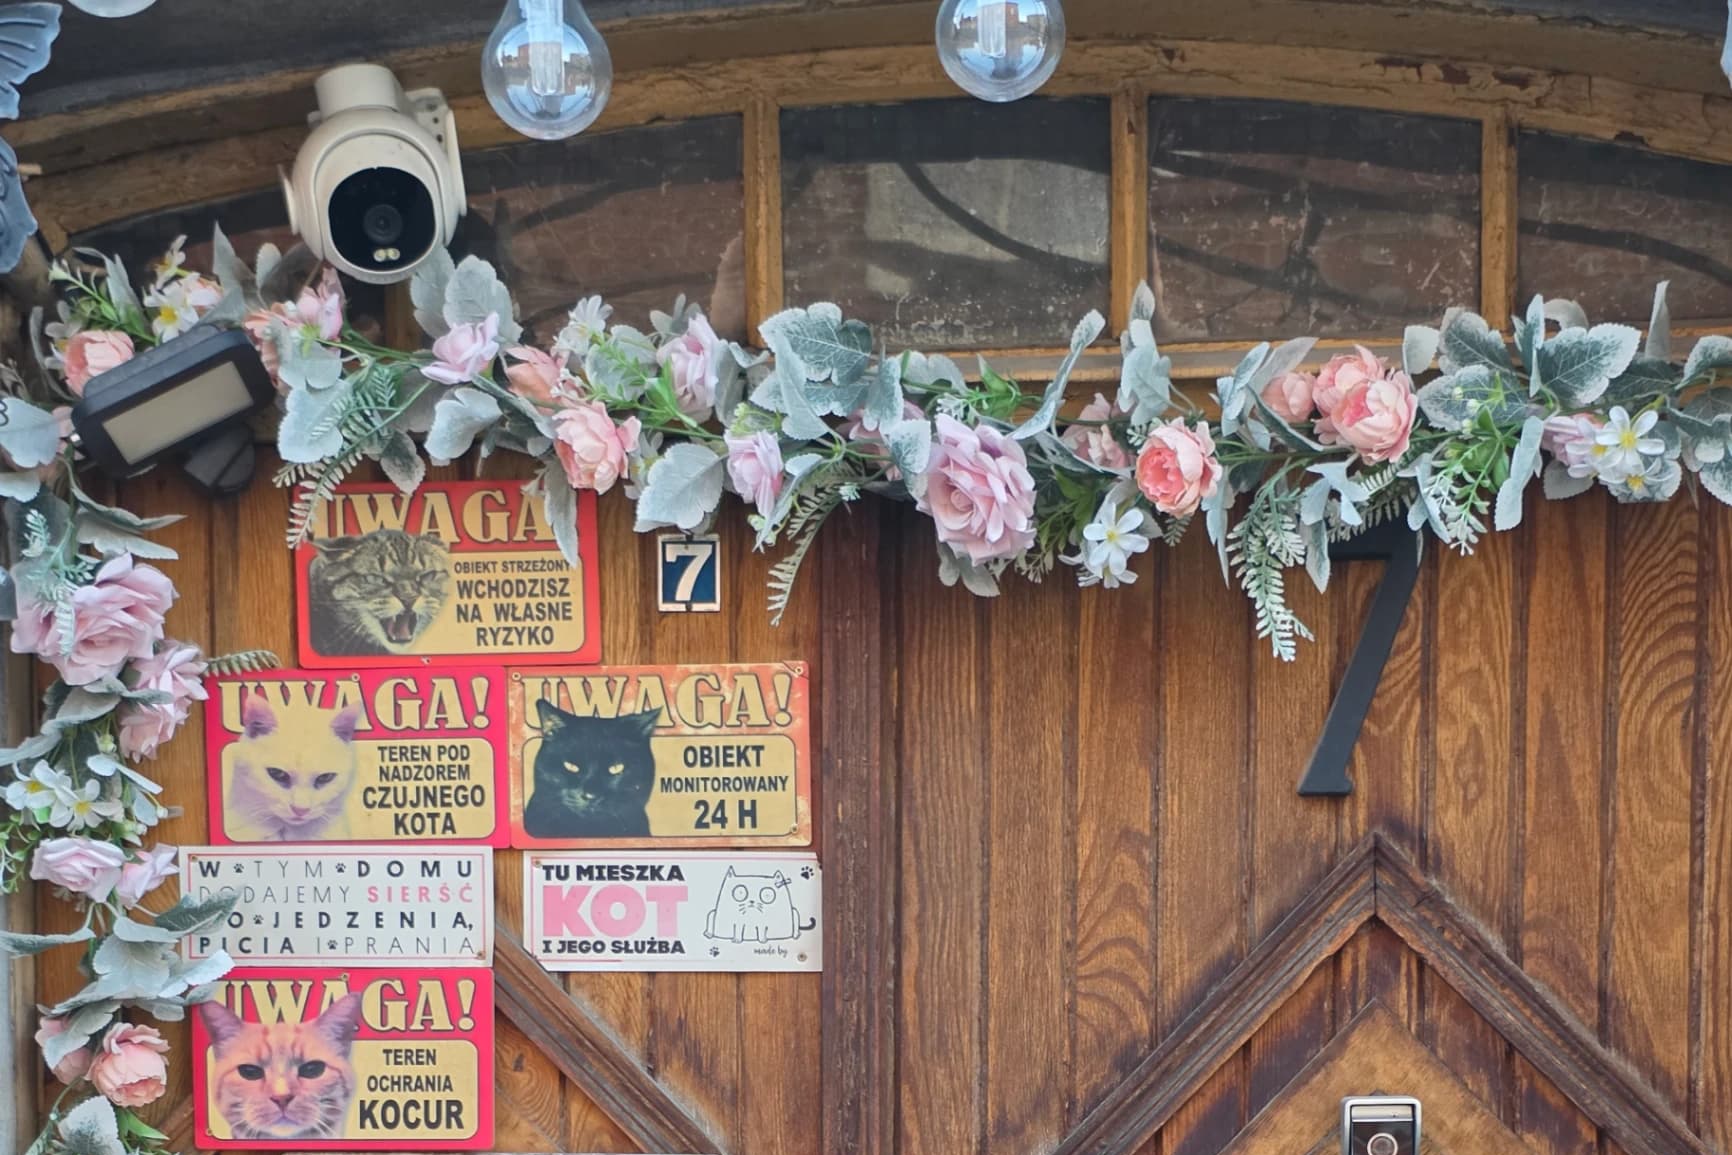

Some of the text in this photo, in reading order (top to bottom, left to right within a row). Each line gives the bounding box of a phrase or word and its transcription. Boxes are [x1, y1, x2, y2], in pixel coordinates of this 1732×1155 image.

[454, 557, 570, 574] OBIEKT STRZEŻONY
[665, 543, 713, 601] 7
[457, 579, 571, 599] WCHODZISZ
[456, 602, 572, 623] NA WŁASNE
[476, 625, 554, 647] RYZYKO
[218, 676, 490, 731] UWAGA!
[521, 672, 793, 728] UWAGA!
[378, 744, 470, 762] TEREN POD
[683, 745, 765, 768] OBIEKT
[379, 764, 470, 782] NADZOREM
[660, 776, 788, 793] MONITOROWANY
[363, 785, 485, 809] CZUJNEGO
[394, 812, 457, 835] KOTA
[694, 799, 757, 829] 24 H
[199, 860, 472, 877] W TYM DOMU
[543, 865, 685, 881] TU MIESZKA
[273, 911, 473, 931] JEDZENIA,
[542, 885, 688, 938] KOT
[199, 937, 294, 954] PICIA
[344, 937, 474, 954] PRANIA
[542, 937, 686, 954] I JEGO SŁUŻBA
[383, 1049, 436, 1066] TEREN
[367, 1075, 453, 1092] OCHRANIA
[359, 1099, 464, 1130] KOCUR
